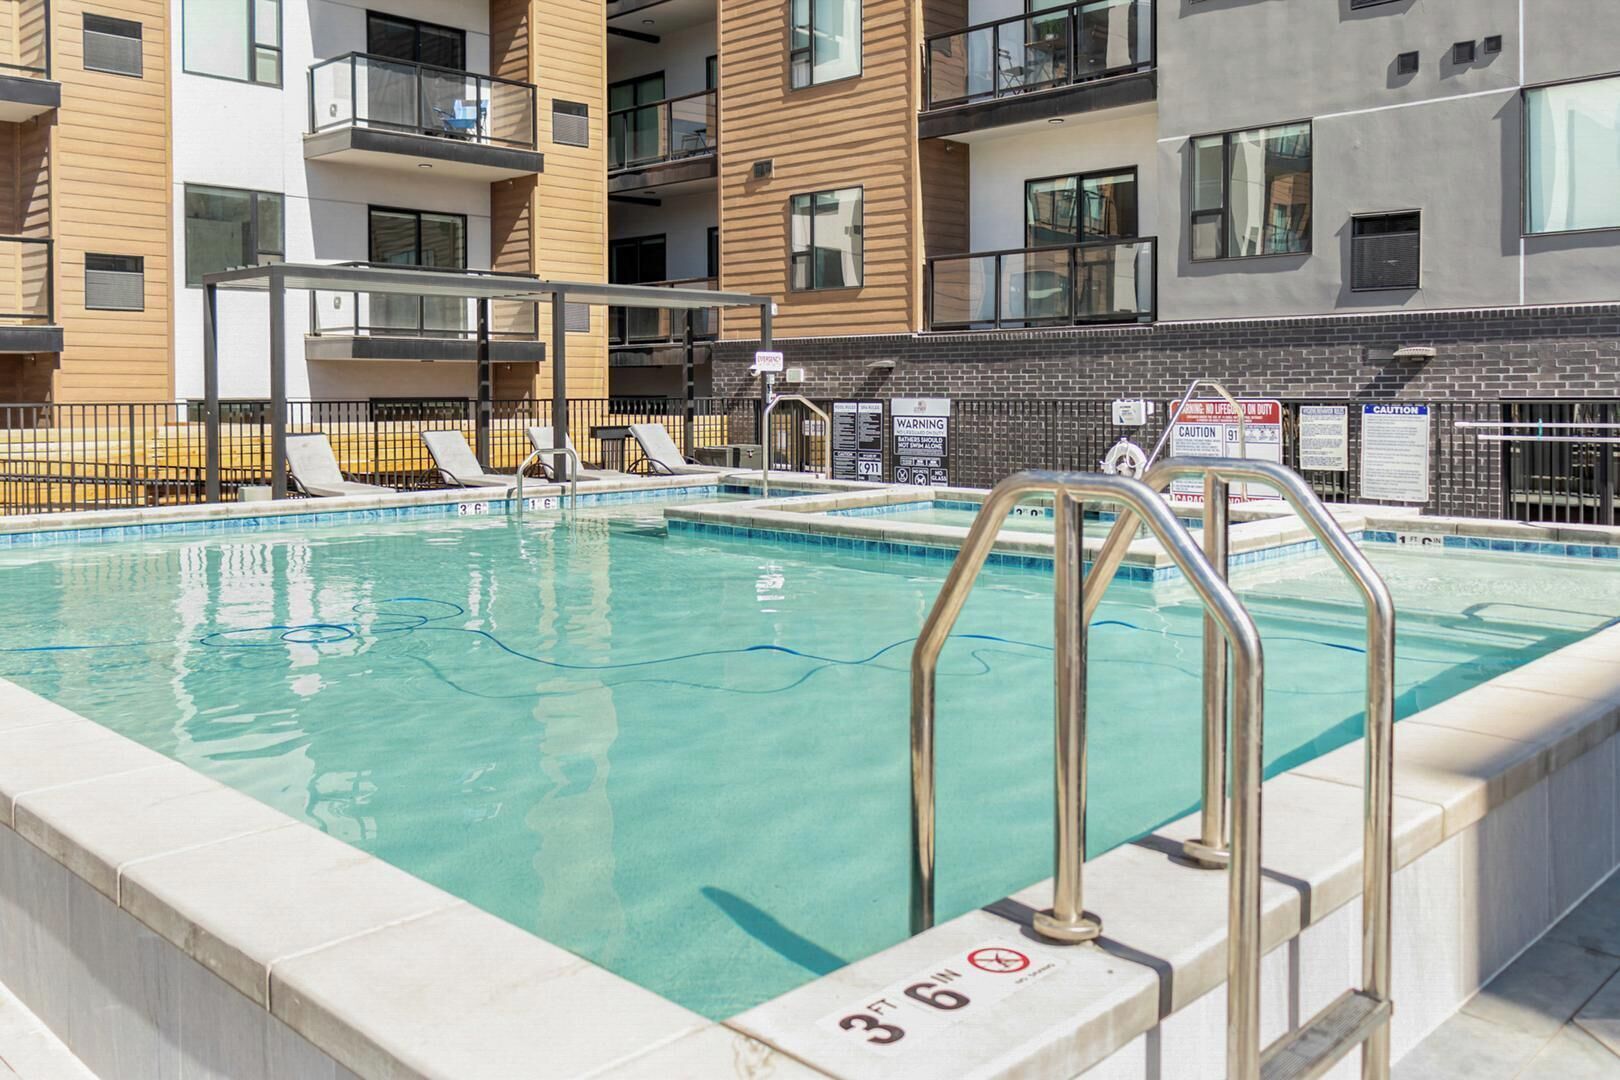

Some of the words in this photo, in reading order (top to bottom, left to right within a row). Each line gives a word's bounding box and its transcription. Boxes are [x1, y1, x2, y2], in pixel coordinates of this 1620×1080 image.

[1206, 403, 1214, 414] NO
[1247, 403, 1256, 415] ON
[1257, 403, 1273, 415] DUTY
[1373, 406, 1418, 414] CAUTION
[897, 418, 944, 430] WARNING
[1179, 426, 1216, 438] CAUTION
[1228, 429, 1238, 440] 91
[864, 462, 879, 474] 911
[1399, 536, 1406, 544] 1
[930, 968, 962, 984] IN
[903, 982, 971, 1010] 6
[867, 998, 898, 1016] FT
[839, 1014, 905, 1044] 3
